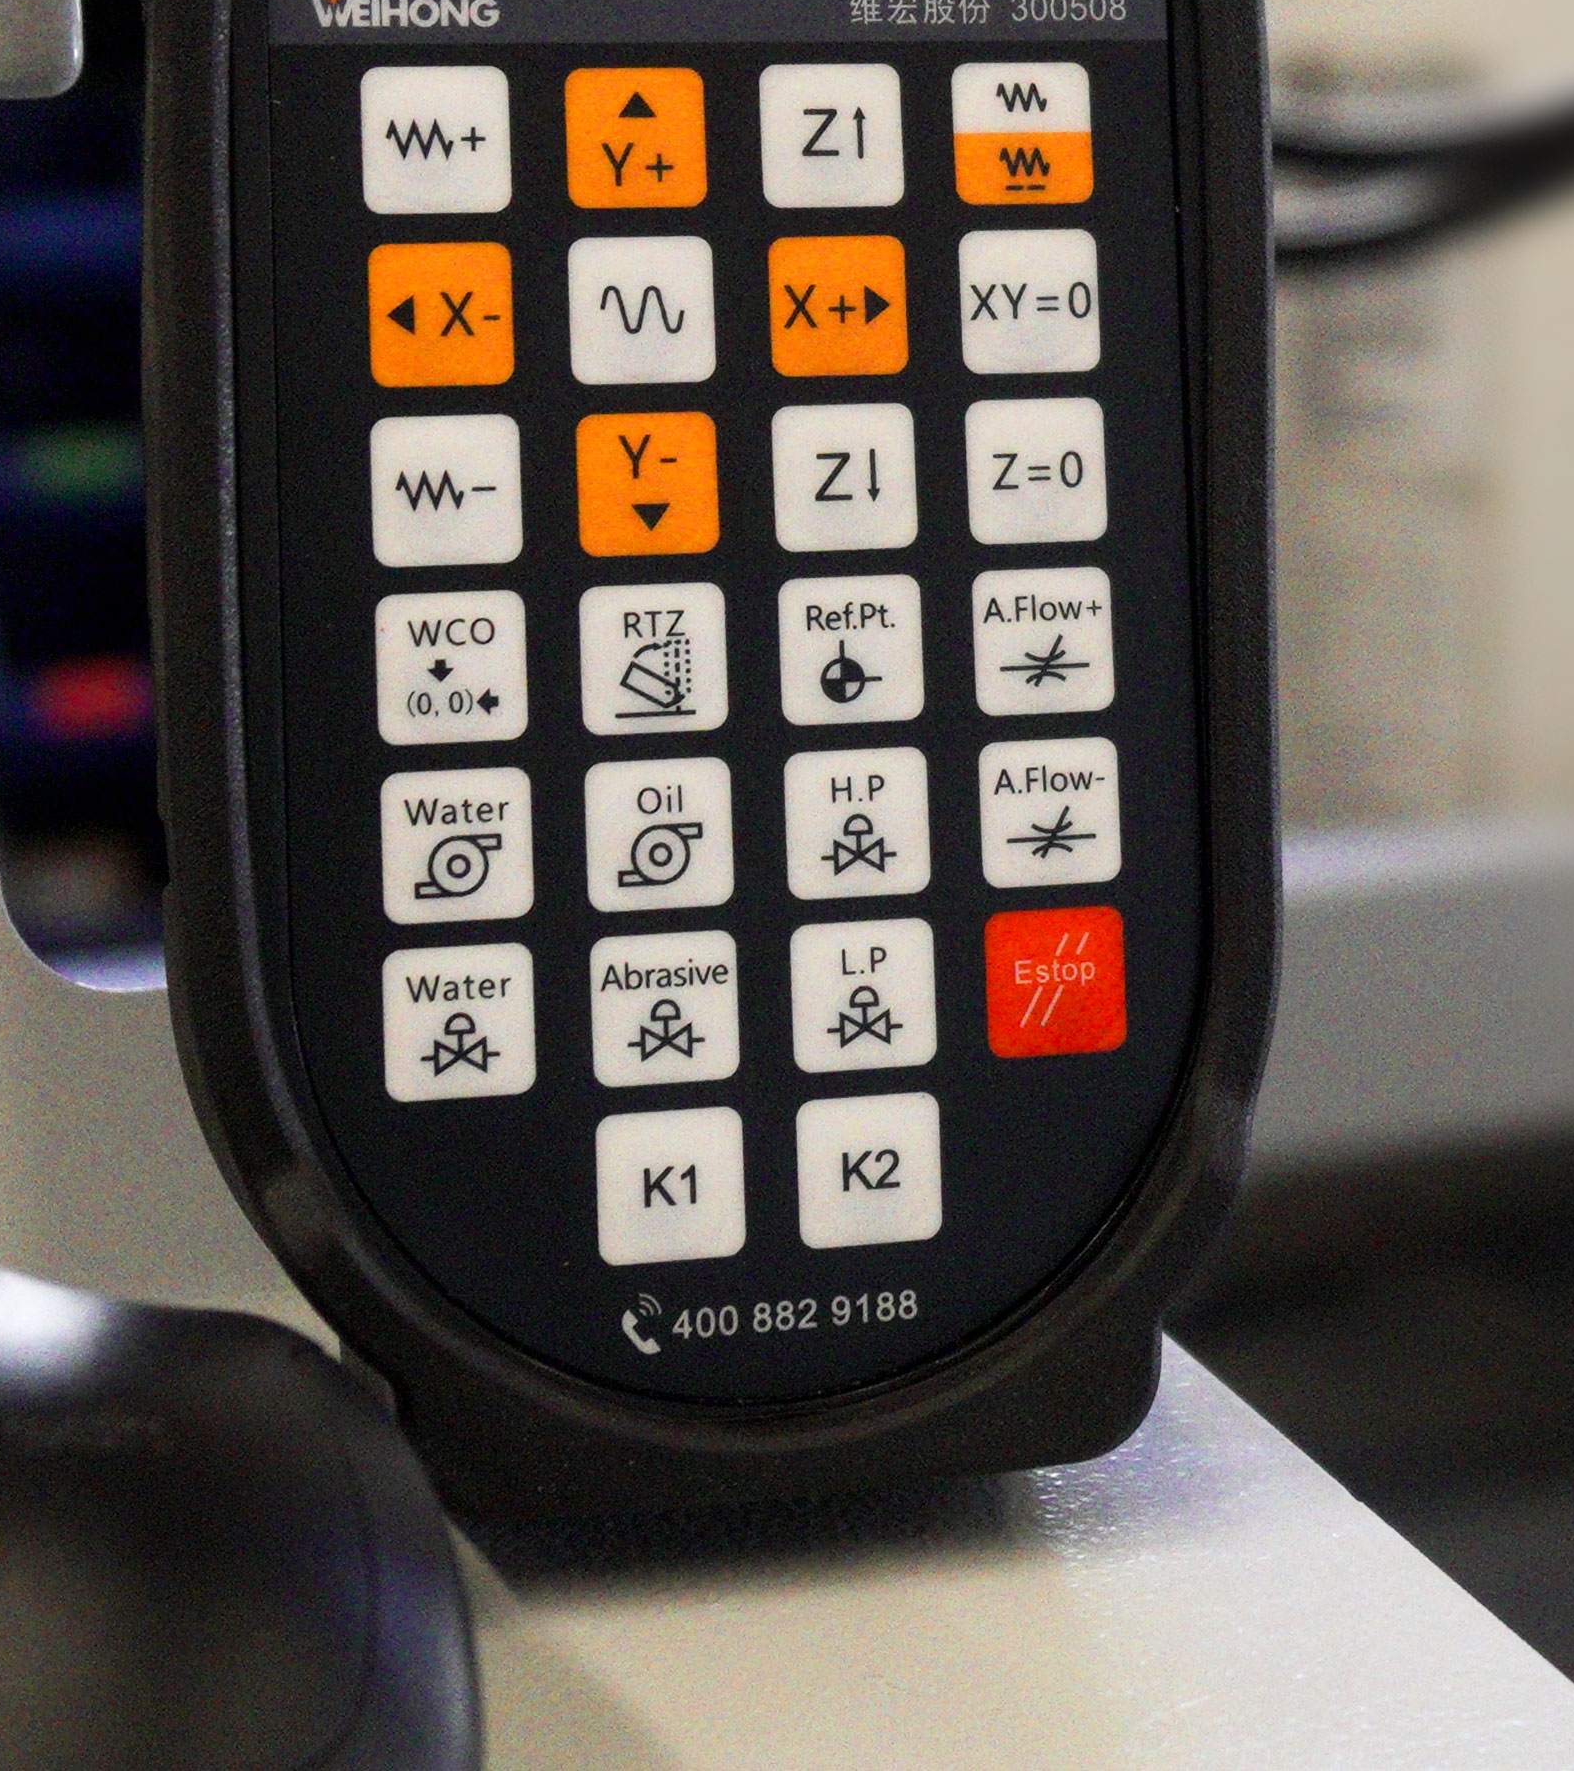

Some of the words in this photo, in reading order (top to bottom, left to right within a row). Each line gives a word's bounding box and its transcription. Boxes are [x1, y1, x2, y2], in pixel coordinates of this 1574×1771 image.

[601, 142, 674, 187] Y+
[440, 291, 500, 338] X-
[784, 284, 856, 329] X+
[969, 281, 1092, 321] XY=0
[618, 434, 677, 480] Y-
[992, 450, 1085, 492] Z=0
[622, 610, 685, 639] RTZ
[805, 602, 897, 632] Ref.Pt.
[982, 596, 1104, 625] A.Flow+
[407, 617, 496, 648] WCO
[830, 773, 886, 803] H.P
[993, 765, 1104, 795] A.Flow-
[403, 797, 510, 828] Water
[635, 785, 684, 816] Oil
[600, 959, 731, 992] Abrasive
[840, 945, 888, 977] L.P
[1013, 958, 1098, 986] Estop
[405, 975, 510, 1004] Water
[841, 1148, 901, 1192] K2
[643, 1164, 698, 1209] K1
[672, 1304, 739, 1339] 400
[752, 1297, 818, 1333] 882
[830, 1289, 919, 1326] 9188
